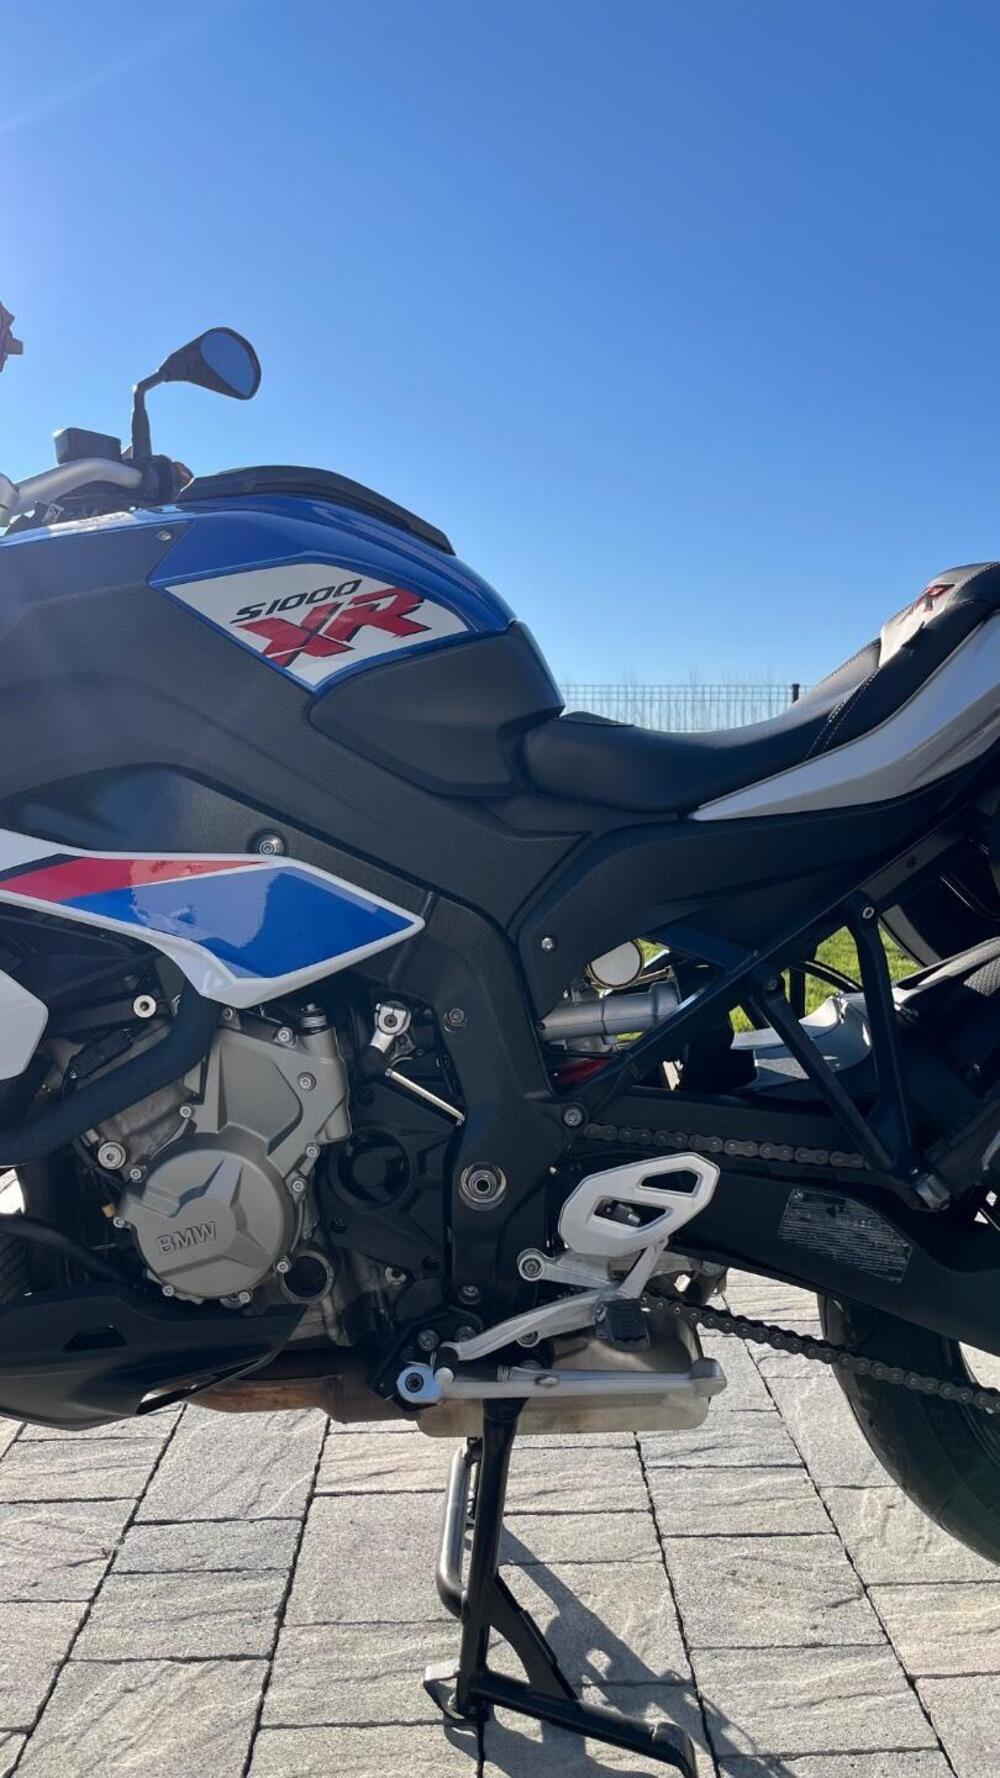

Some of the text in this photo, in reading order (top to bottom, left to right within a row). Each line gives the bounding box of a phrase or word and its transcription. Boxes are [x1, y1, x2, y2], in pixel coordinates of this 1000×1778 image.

[229, 579, 363, 624] S1000
[235, 587, 432, 667] XR
[157, 1219, 217, 1255] BMW
